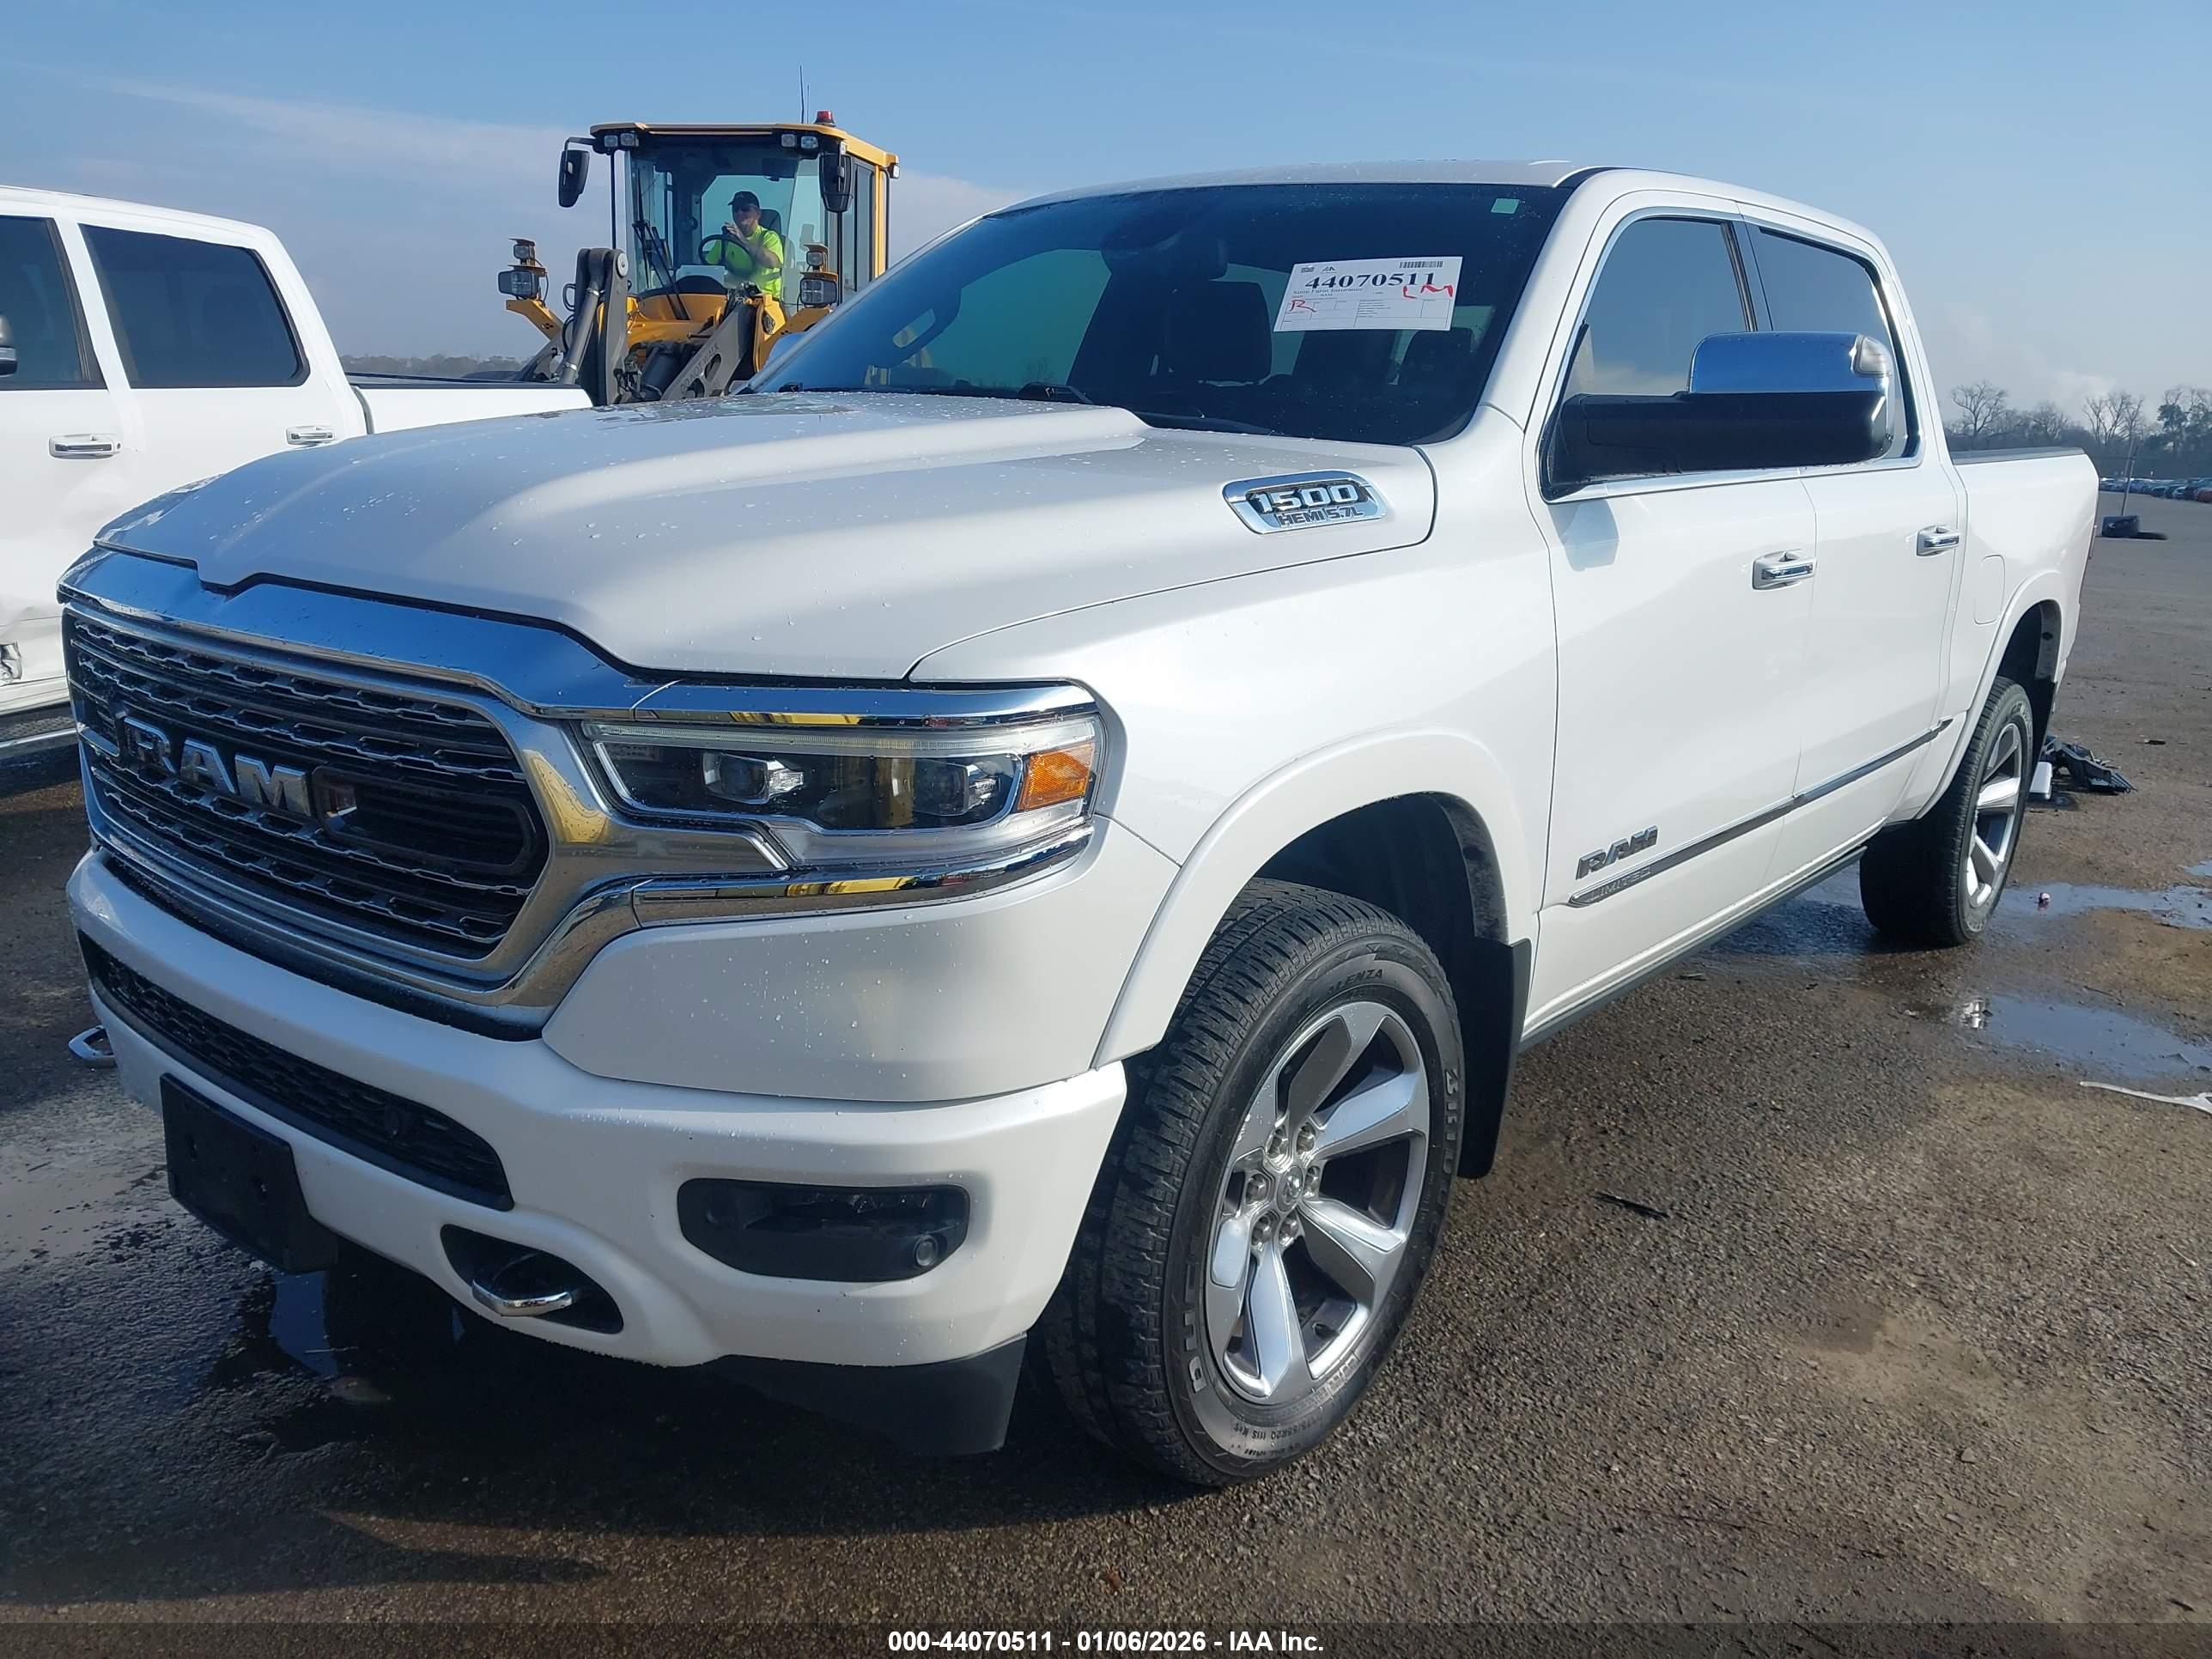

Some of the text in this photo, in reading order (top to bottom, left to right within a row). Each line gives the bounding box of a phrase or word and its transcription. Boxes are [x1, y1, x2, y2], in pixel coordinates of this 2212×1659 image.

[1305, 272, 1434, 289] 44070511
[1253, 483, 1359, 513] 1500
[1277, 506, 1364, 526] HEMI 5.7L
[120, 715, 313, 817] RAM
[1576, 825, 1658, 880] RAM
[1591, 866, 1650, 900] LIMITED
